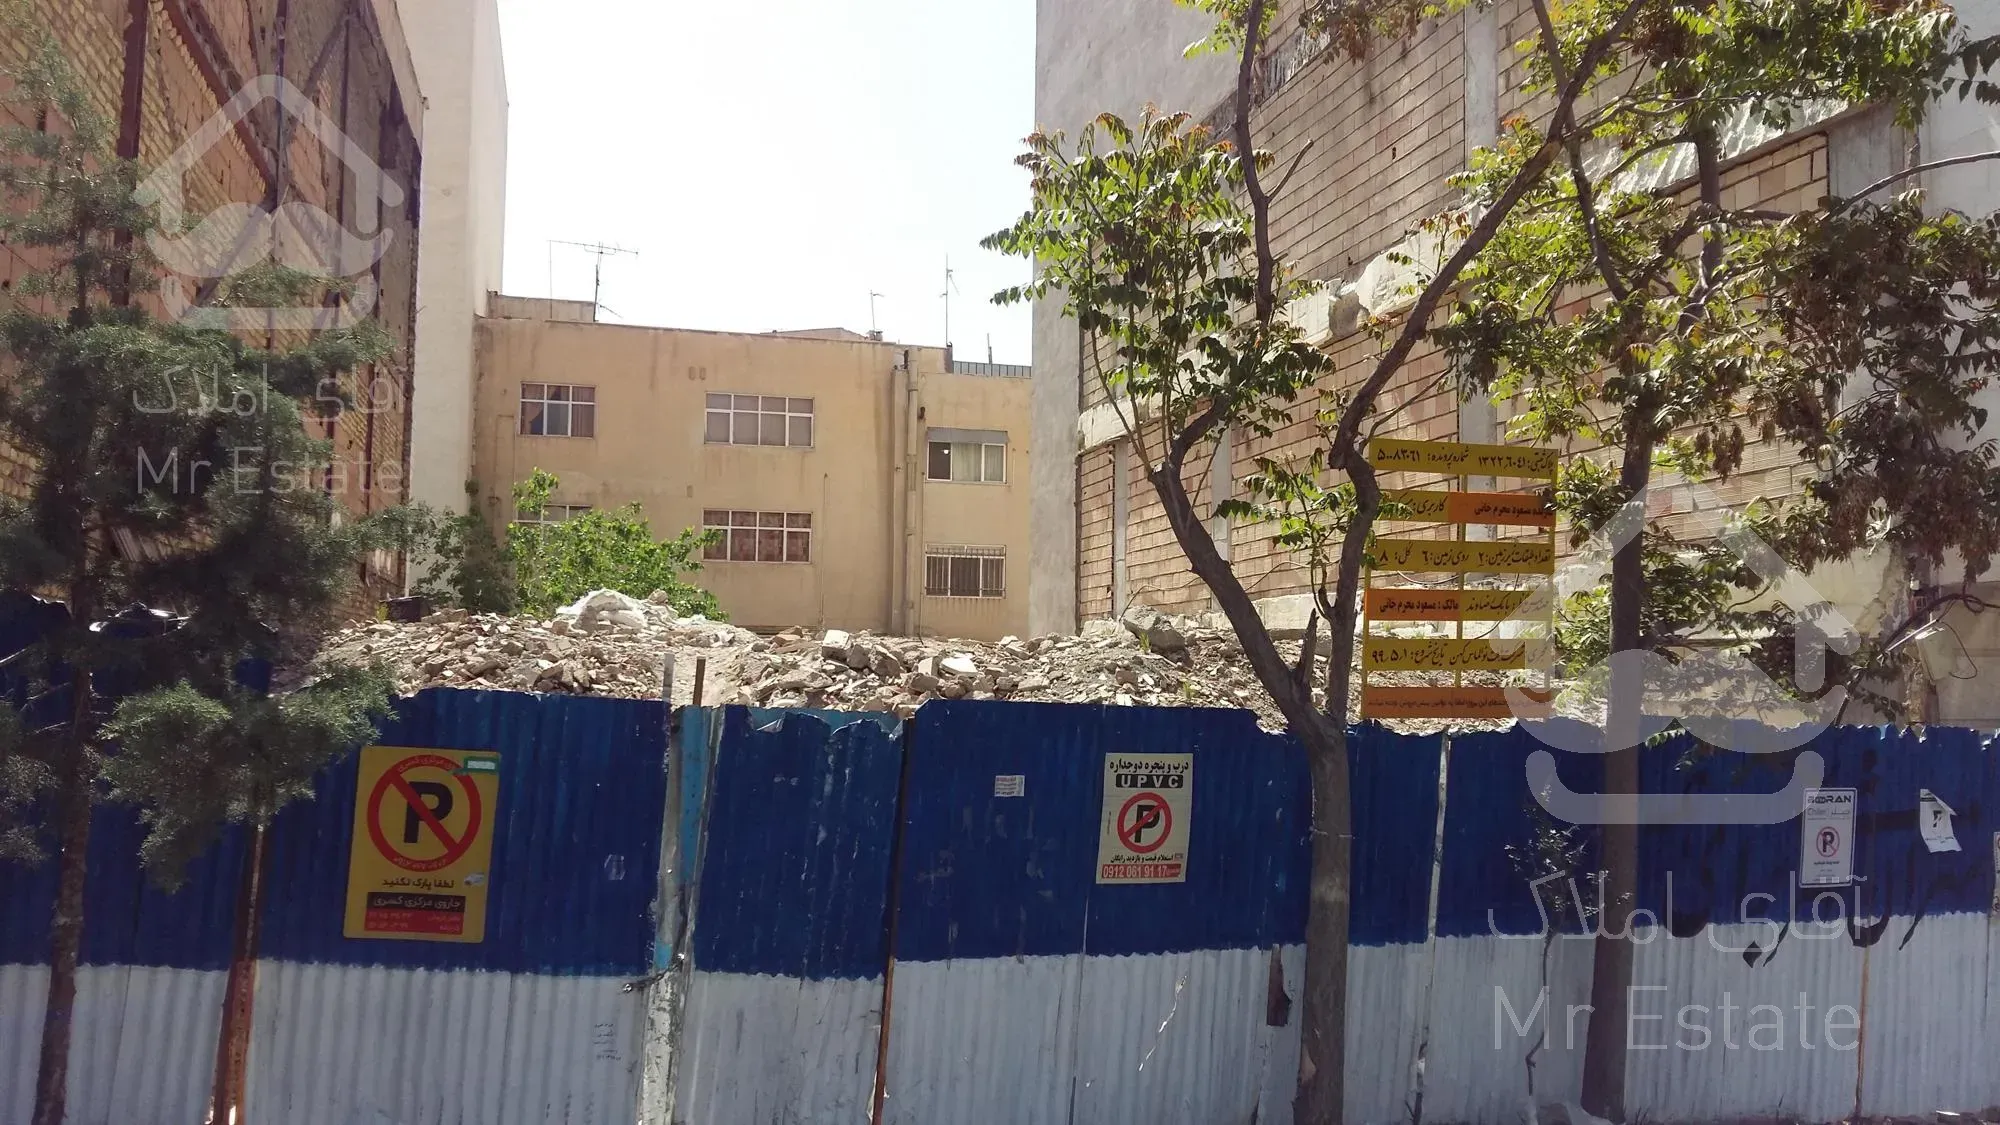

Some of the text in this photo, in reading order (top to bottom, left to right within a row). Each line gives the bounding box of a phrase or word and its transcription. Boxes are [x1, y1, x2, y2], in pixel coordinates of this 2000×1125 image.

[1144, 761, 1166, 774] پنجره
[1173, 759, 1189, 773] درب
[1121, 775, 1179, 788] UPVC
[1103, 865, 1124, 878] 0912
[381, 877, 455, 890] لطفا پارک نکنید
[404, 895, 433, 908] مرکزی
